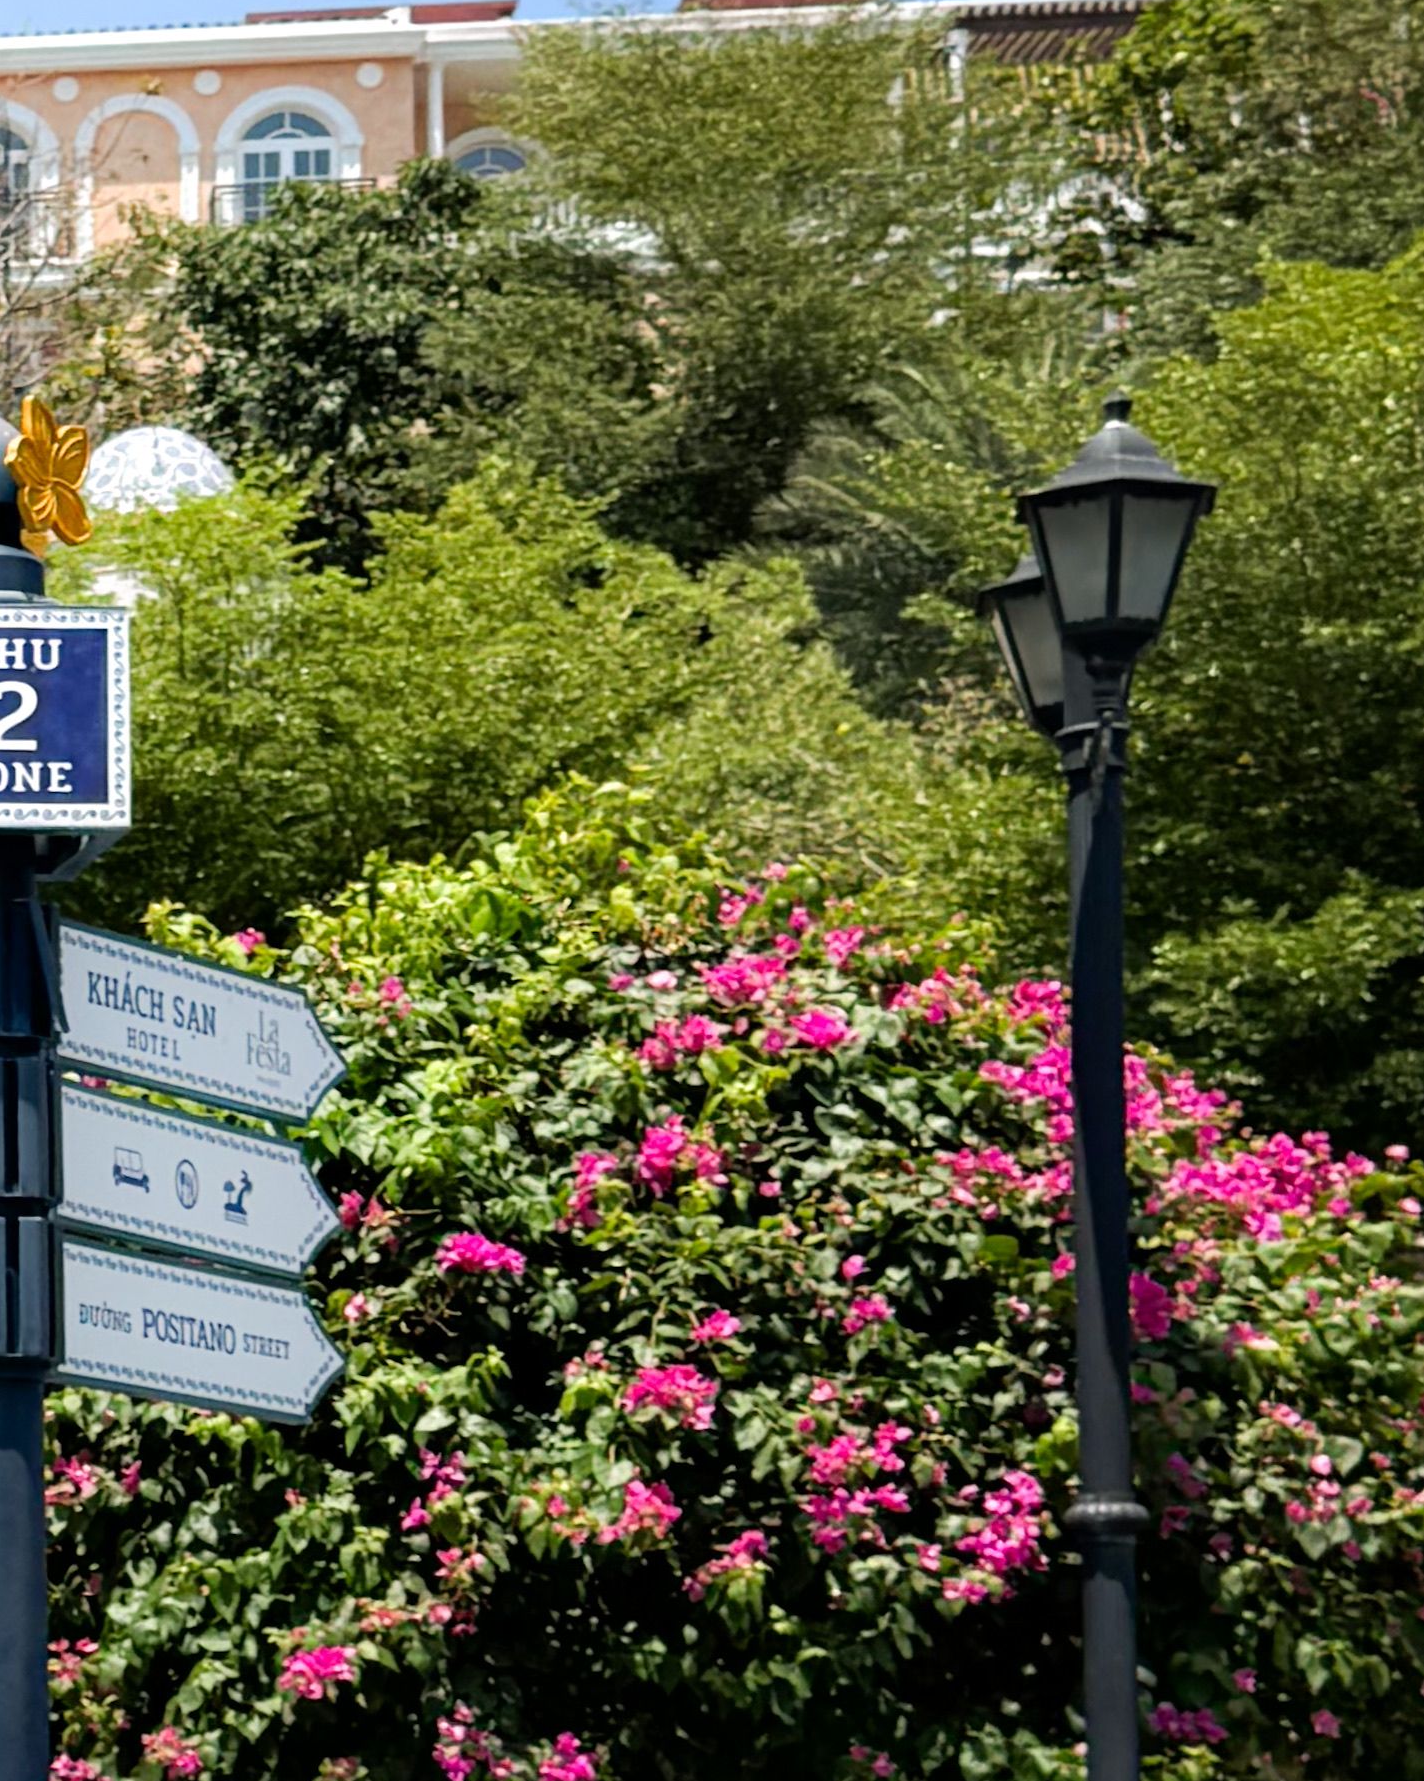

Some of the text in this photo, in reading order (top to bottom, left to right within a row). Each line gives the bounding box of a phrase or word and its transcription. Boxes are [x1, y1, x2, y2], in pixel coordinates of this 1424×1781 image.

[87, 971, 217, 1039] KHÁCH SẠN
[126, 1026, 181, 1062] HOTEL
[258, 1010, 280, 1045] La
[246, 1032, 292, 1076] Festa
[141, 1307, 237, 1356] POSITANO
[242, 1332, 291, 1361] STREET
